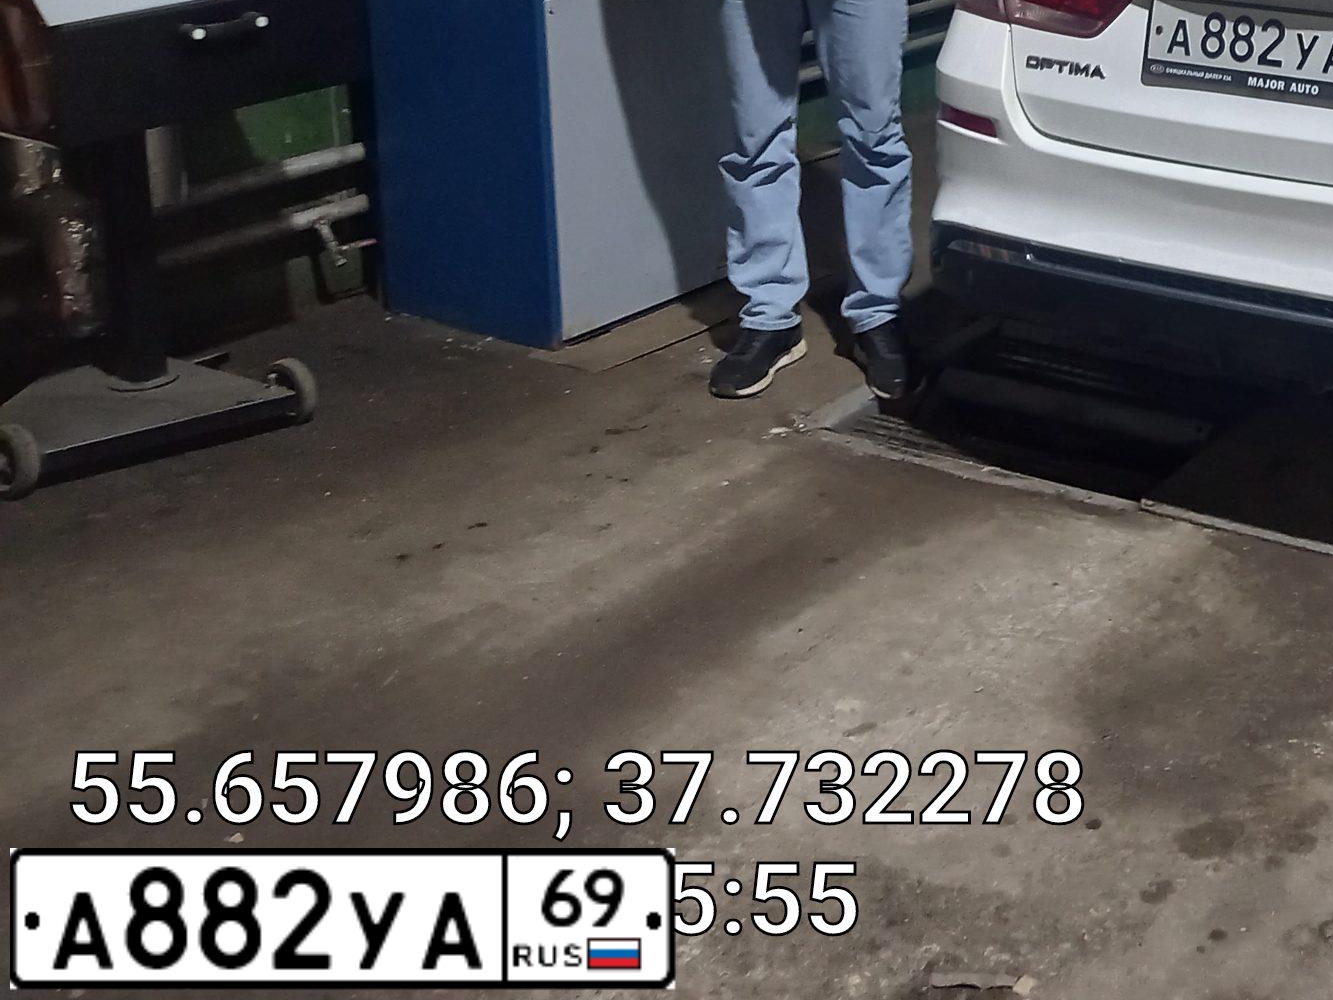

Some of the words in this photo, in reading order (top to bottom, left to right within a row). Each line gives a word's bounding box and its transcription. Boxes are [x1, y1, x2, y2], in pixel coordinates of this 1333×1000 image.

[1025, 54, 1107, 81] OPTIMA
[1247, 76, 1286, 91] MAJOR
[1289, 82, 1320, 96] AUTO
